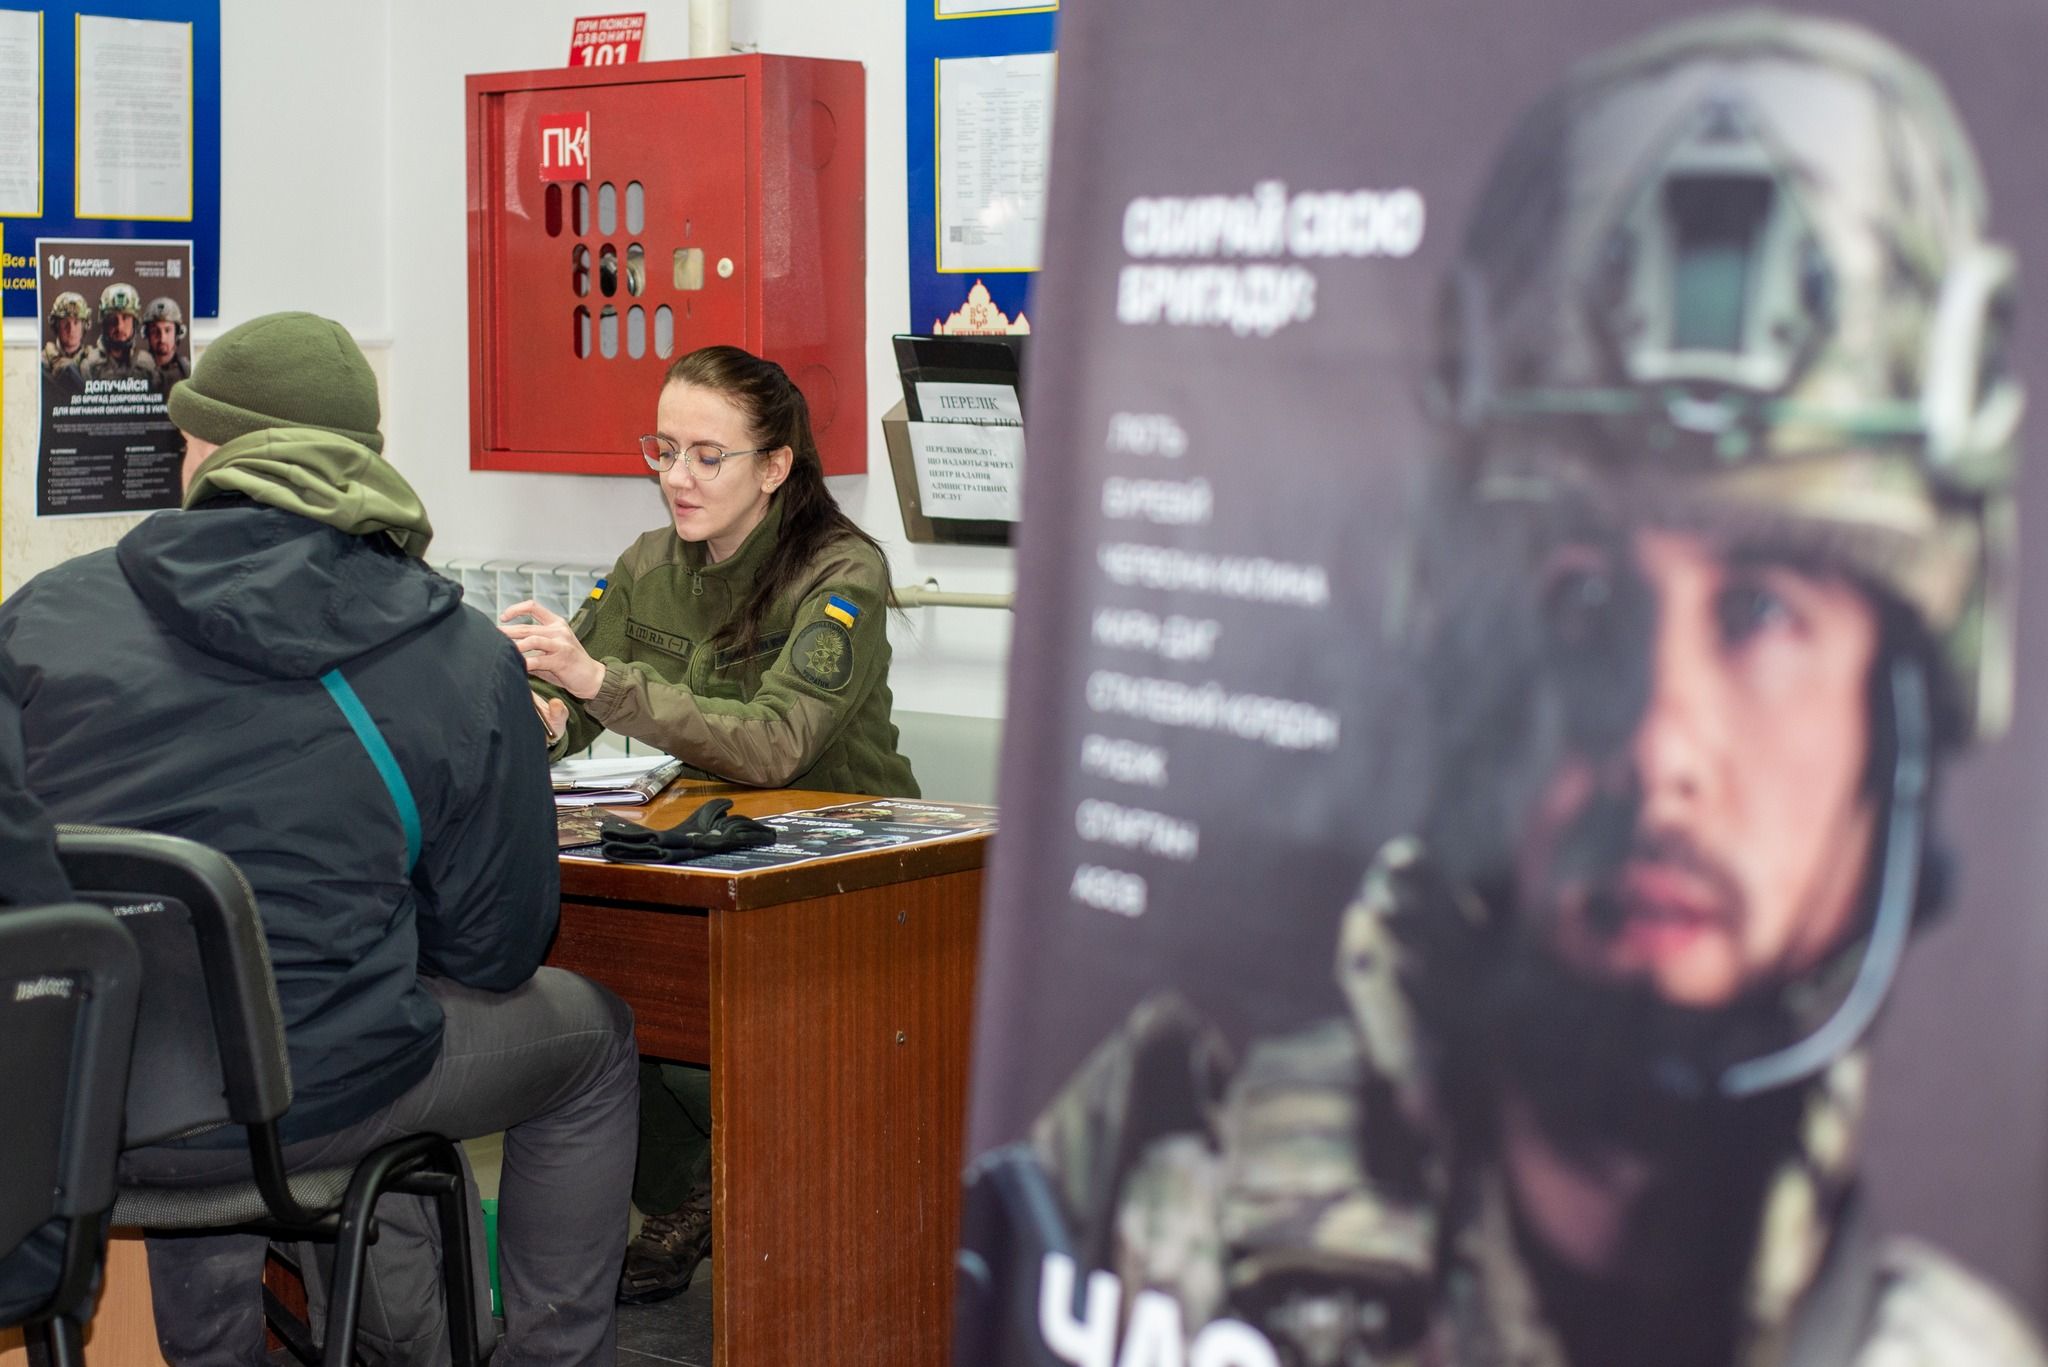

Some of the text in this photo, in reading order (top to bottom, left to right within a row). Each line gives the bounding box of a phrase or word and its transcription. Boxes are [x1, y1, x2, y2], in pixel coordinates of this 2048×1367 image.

[575, 16, 643, 33] ПРИ ПОЖЕЖІ
[572, 29, 641, 47] ДЗВОНИТИ
[581, 43, 628, 67] 101
[69, 267, 115, 277] НАСТУПУ
[85, 377, 148, 394] ДОЛУЧАЙСЯ
[939, 395, 999, 410] ПЕРЕЛІК
[927, 457, 1015, 470] ЩО НАДАЮТЬСЯ ЧЕРЕЗ
[929, 469, 991, 480] ЦЕНТР НАДАННЯ
[932, 482, 1008, 493] АДМІНІСТРАТИВНИХ
[932, 492, 961, 501] ПОСЛУГ
